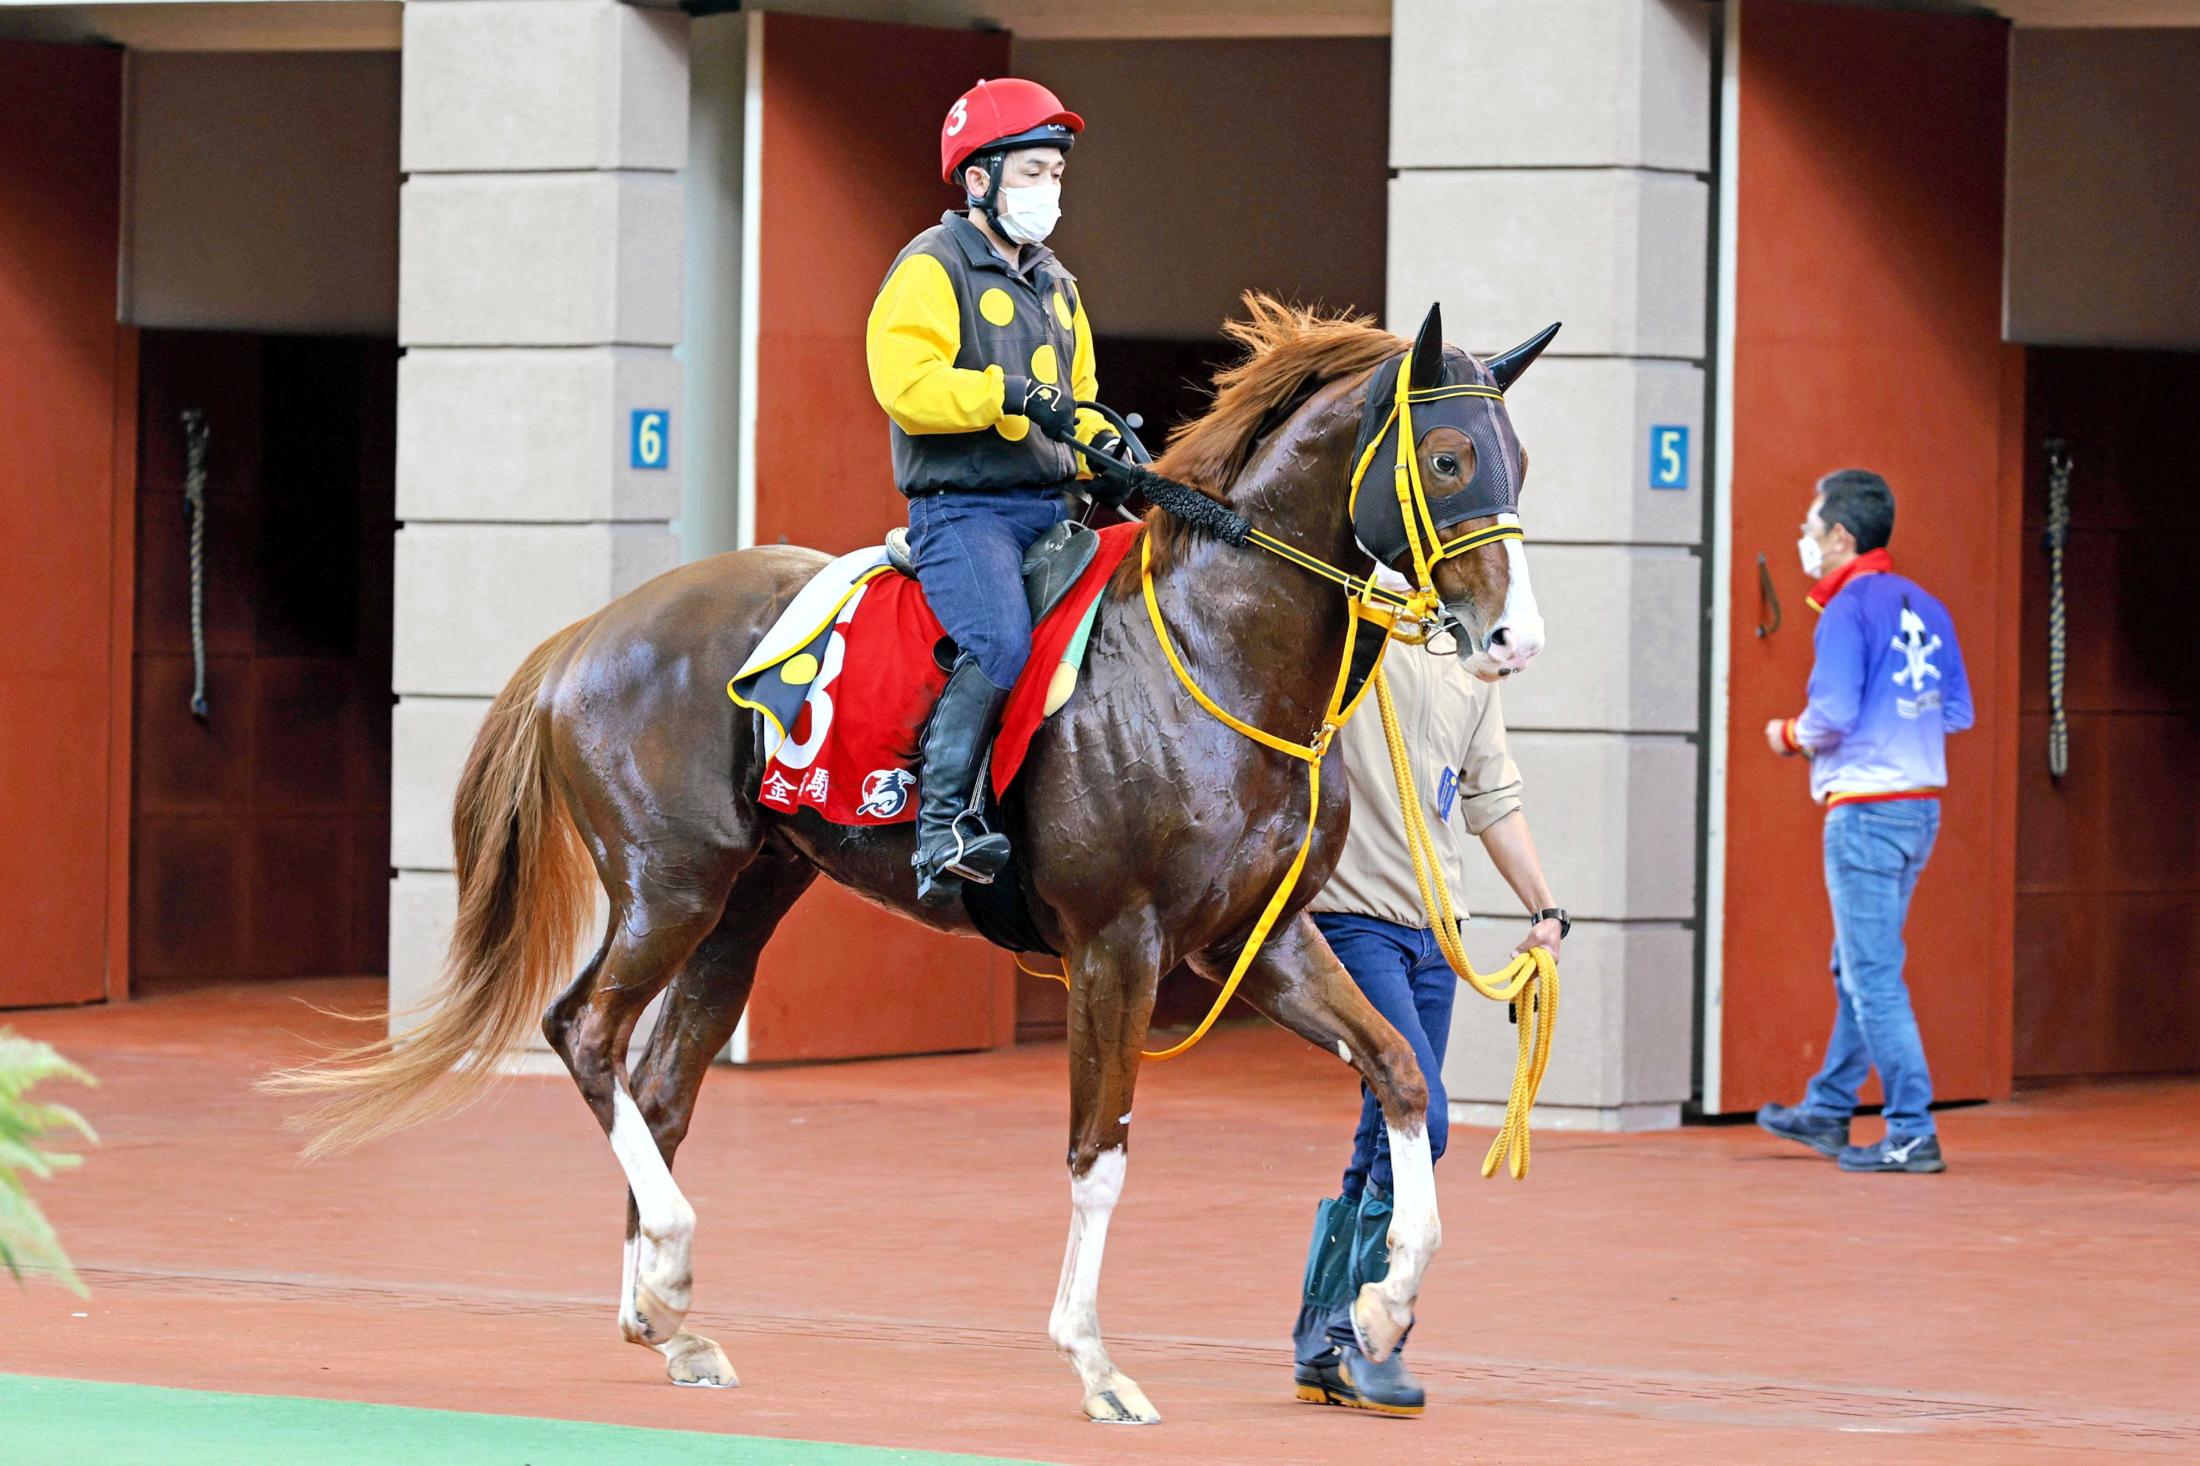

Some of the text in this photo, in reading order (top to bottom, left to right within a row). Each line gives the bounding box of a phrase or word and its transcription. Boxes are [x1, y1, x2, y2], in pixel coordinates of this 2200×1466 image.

[947, 98, 967, 136] 3
[640, 414, 661, 464] 6
[1660, 431, 1681, 483] 5
